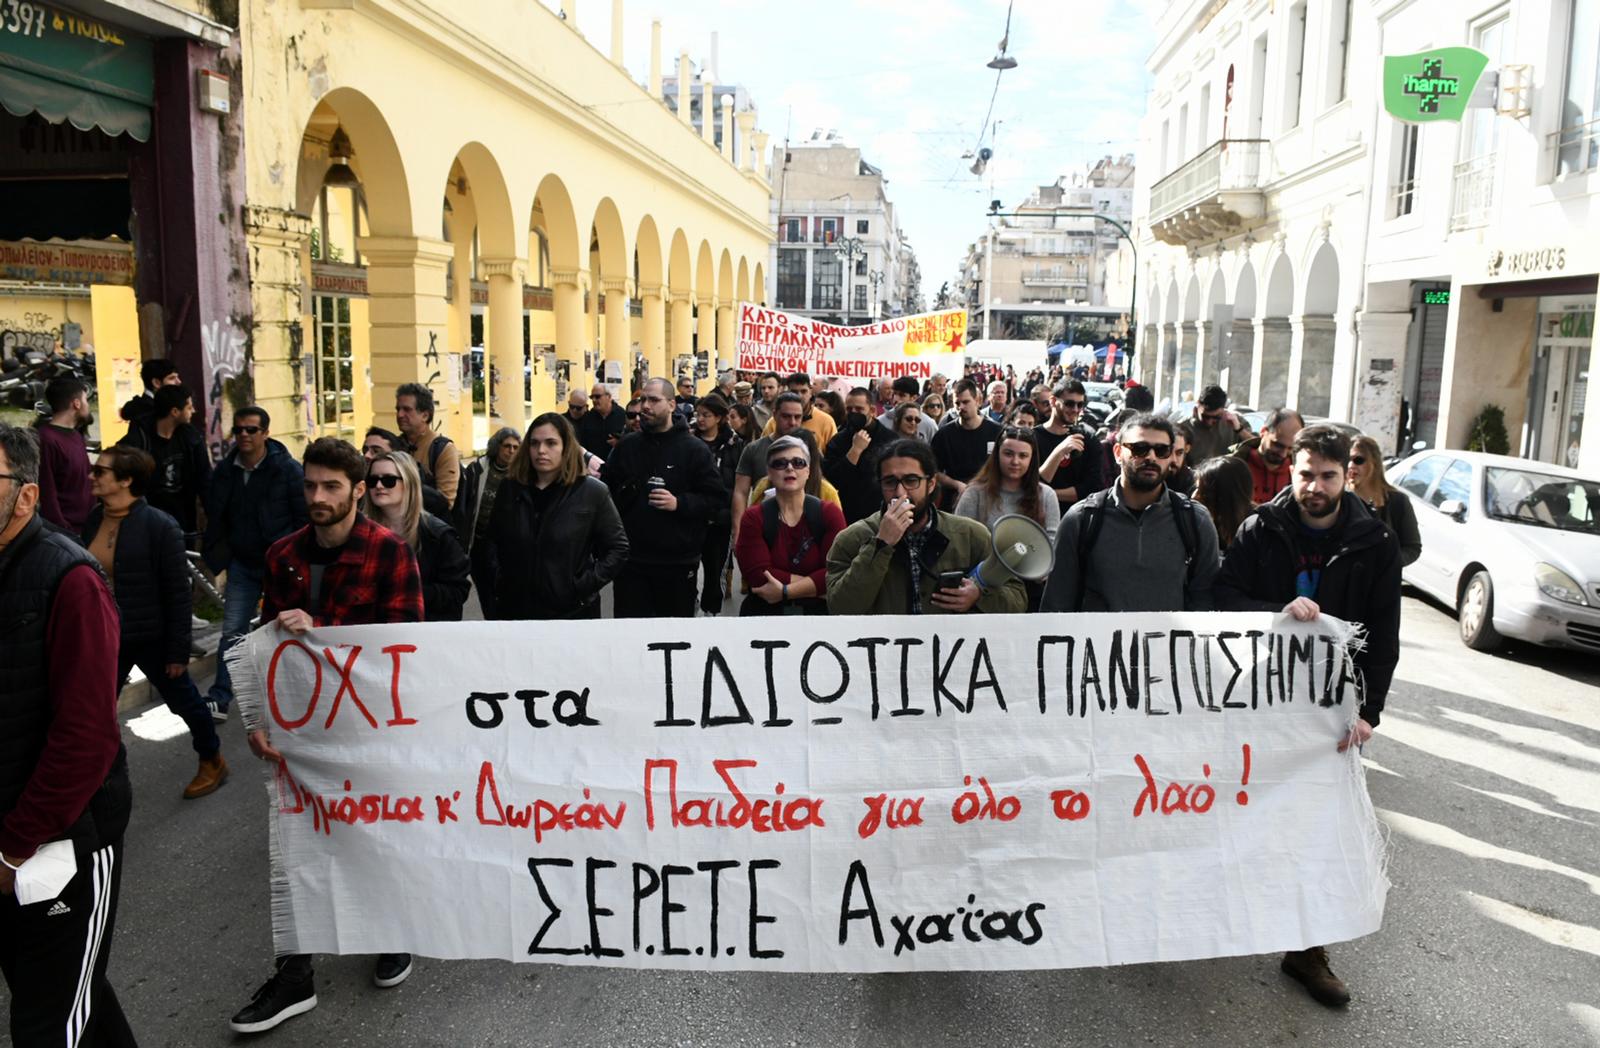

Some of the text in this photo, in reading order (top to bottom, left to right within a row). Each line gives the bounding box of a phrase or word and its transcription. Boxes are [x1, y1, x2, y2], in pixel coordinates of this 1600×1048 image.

[741, 323, 835, 349] ΠΙΕΡΡΑΚΑΚΗ
[742, 306, 788, 327] ΚΑΤΩ
[811, 319, 906, 339] ΝΟΜΟΣΧΕΔΙΟ
[740, 341, 824, 361] ΟΧΙ ΣΤΗΝ ΙΔΡΥΣΗ
[740, 354, 931, 379] ΙΔΙΩΤΙΚΩΝ ΠΑΝΕΠΙΣΤΗΜΙΩΝ
[267, 629, 1356, 730] ΟΧΙ στα ΙΔΙΩΤΙΚΑ ΠΑΝΕΠΙΣΤΗΜΙΑ
[278, 758, 426, 836] Δημόσια
[476, 761, 627, 843] Δωρεάν
[644, 758, 825, 833] Παιδεία
[858, 793, 924, 839] για
[951, 775, 1022, 824] όλο
[1050, 789, 1091, 821] το
[839, 859, 1046, 957] Αχαΐας
